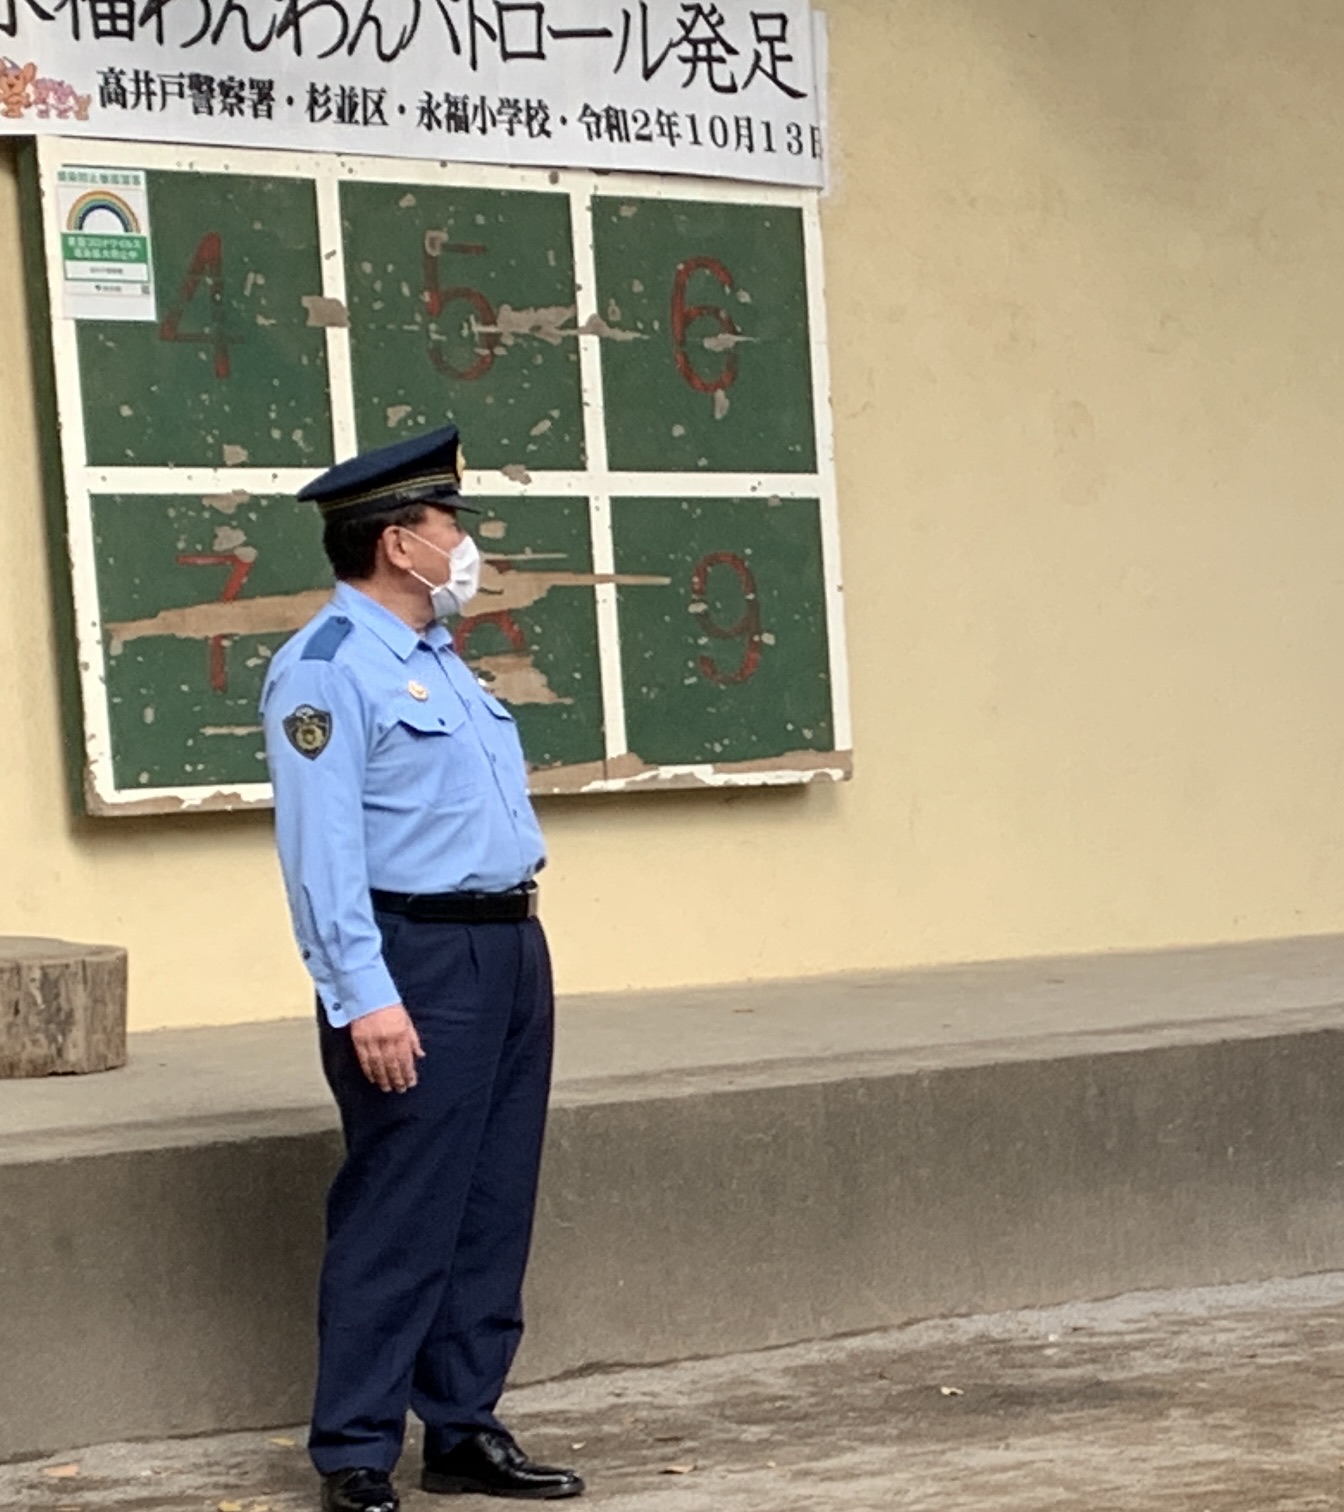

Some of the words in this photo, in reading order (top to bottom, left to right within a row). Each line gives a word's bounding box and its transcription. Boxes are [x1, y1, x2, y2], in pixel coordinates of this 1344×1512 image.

[160, 232, 245, 378] 4
[425, 229, 497, 381] 5
[672, 257, 738, 393] 6
[177, 554, 255, 691] 7
[692, 552, 760, 684] 9
